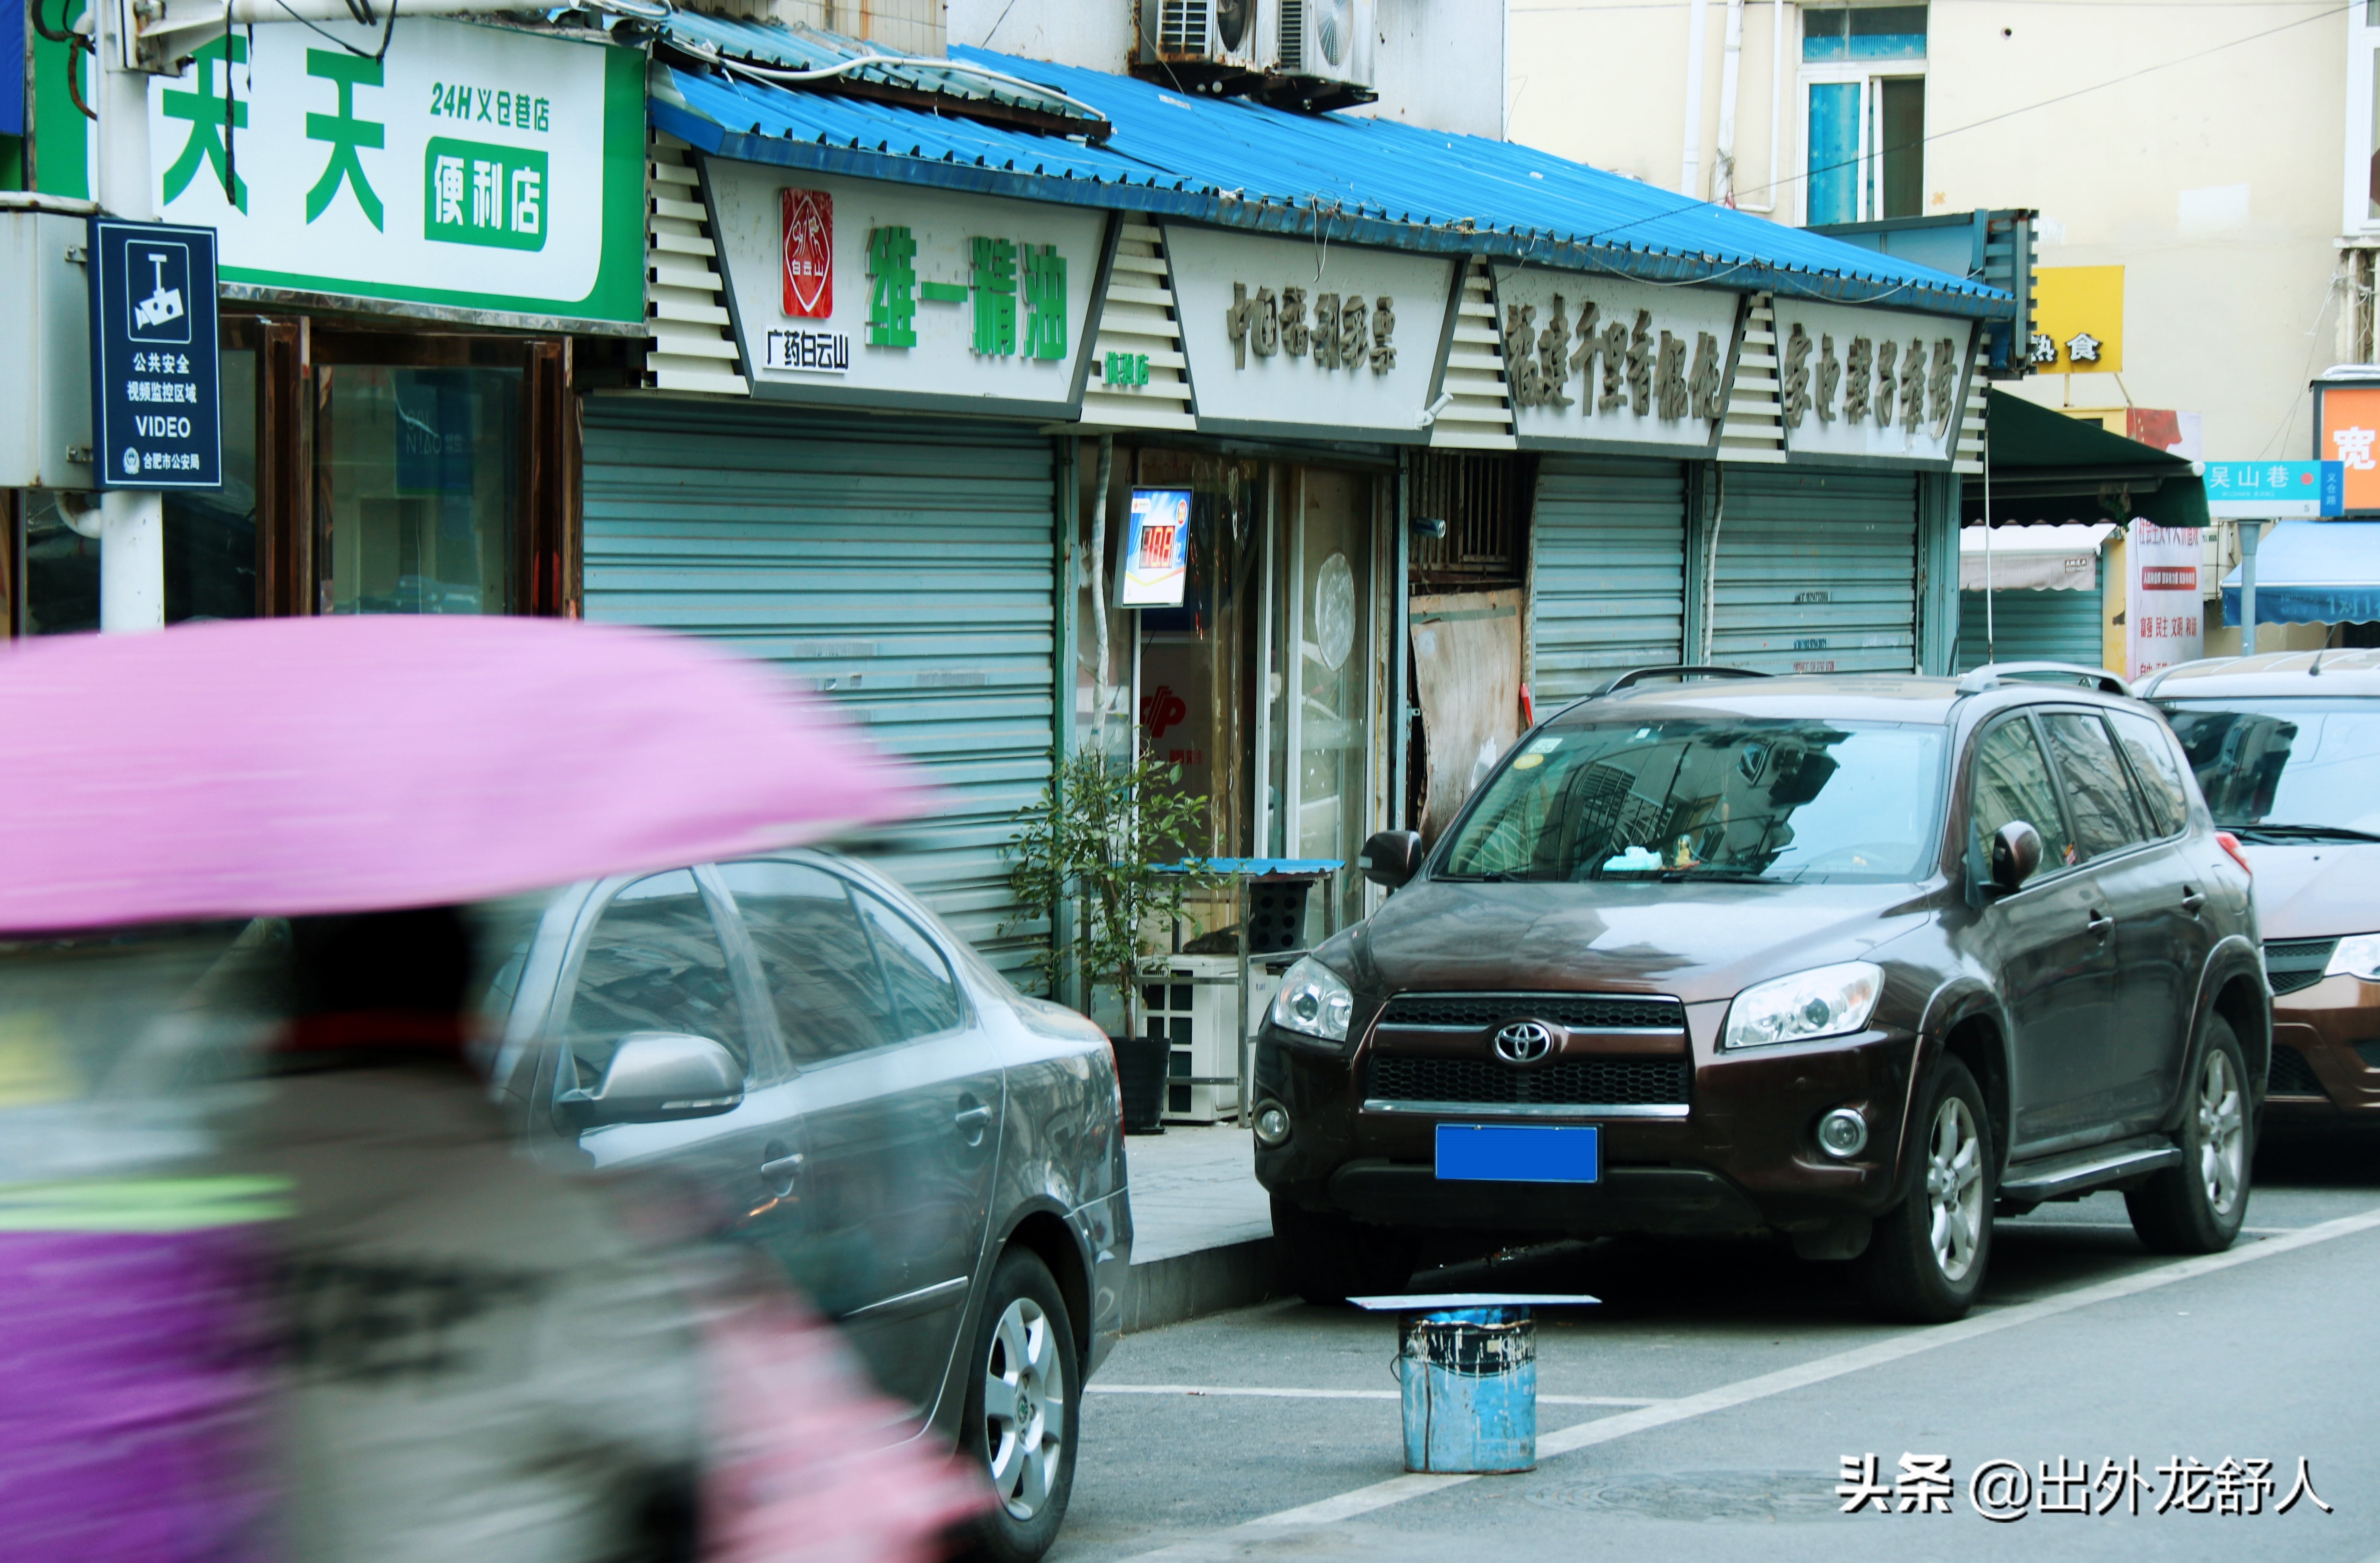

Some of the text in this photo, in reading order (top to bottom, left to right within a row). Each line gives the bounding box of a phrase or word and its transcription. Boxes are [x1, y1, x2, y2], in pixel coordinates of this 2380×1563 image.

[430, 82, 549, 132] 24H义仓巷店
[163, 34, 384, 234] 天天
[434, 154, 540, 234] 便利店
[792, 259, 824, 277] 白云山
[767, 328, 848, 370] 广药白云山
[133, 352, 189, 374] 公共安全
[127, 381, 197, 403] 视频监控区域
[135, 415, 190, 438] VIDEO
[2334, 426, 2375, 470] 宽
[143, 452, 200, 471] 合肥市公安局
[2209, 465, 2289, 488] 吴山巷
[2141, 616, 2197, 638] 富强 民主 文明 和谐
